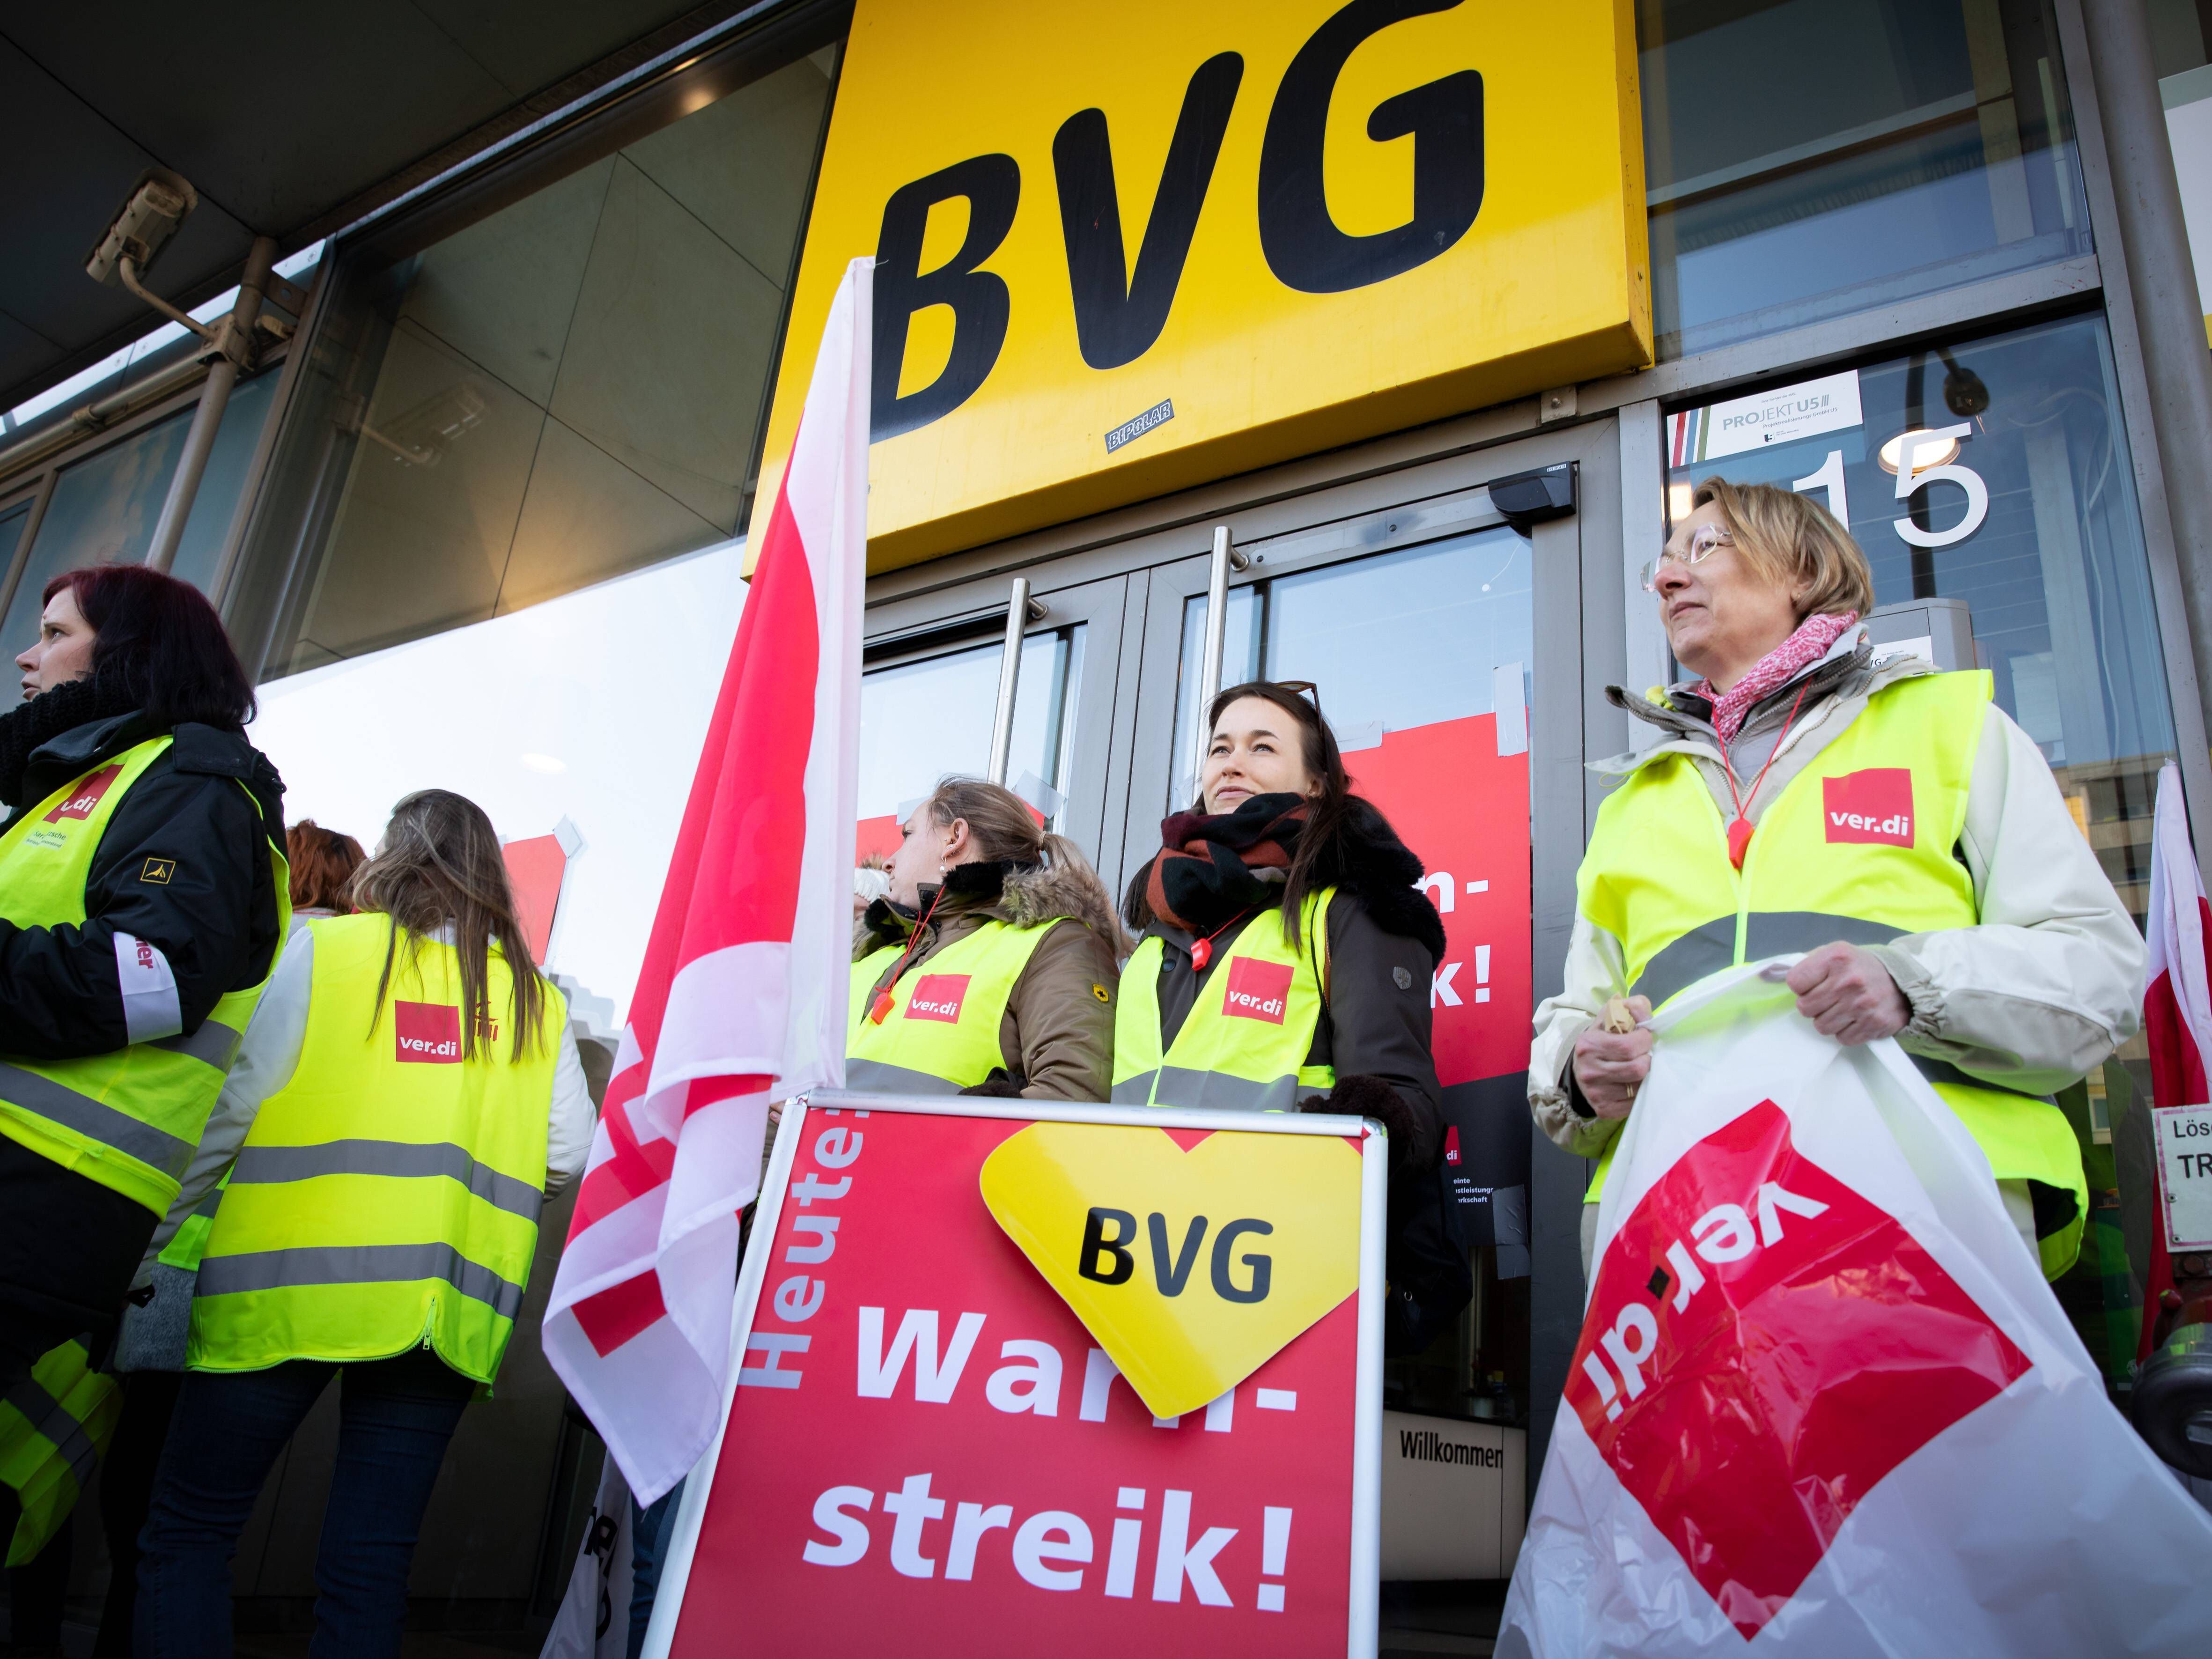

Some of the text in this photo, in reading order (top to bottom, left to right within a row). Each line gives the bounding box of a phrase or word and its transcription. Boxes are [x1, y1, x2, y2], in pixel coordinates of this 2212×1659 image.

[870, 0, 1485, 445] BVG
[1108, 402, 1170, 450] BIPOLAR
[1723, 397, 1819, 430] PROJEKT U5
[1763, 414, 1812, 428] Projektrealisierungs
[1830, 812, 1909, 836] ver.di
[912, 999, 958, 1016] ver.di
[1230, 991, 1283, 1016] ver.di
[400, 1037, 457, 1056] ver.di
[2173, 1119, 2212, 1138] Lös
[1078, 1207, 1274, 1304] BVG
[1582, 1181, 1829, 1423] ver.di
[1401, 1430, 1503, 1468] Willkommen
[803, 1473, 1293, 1611] streik!
